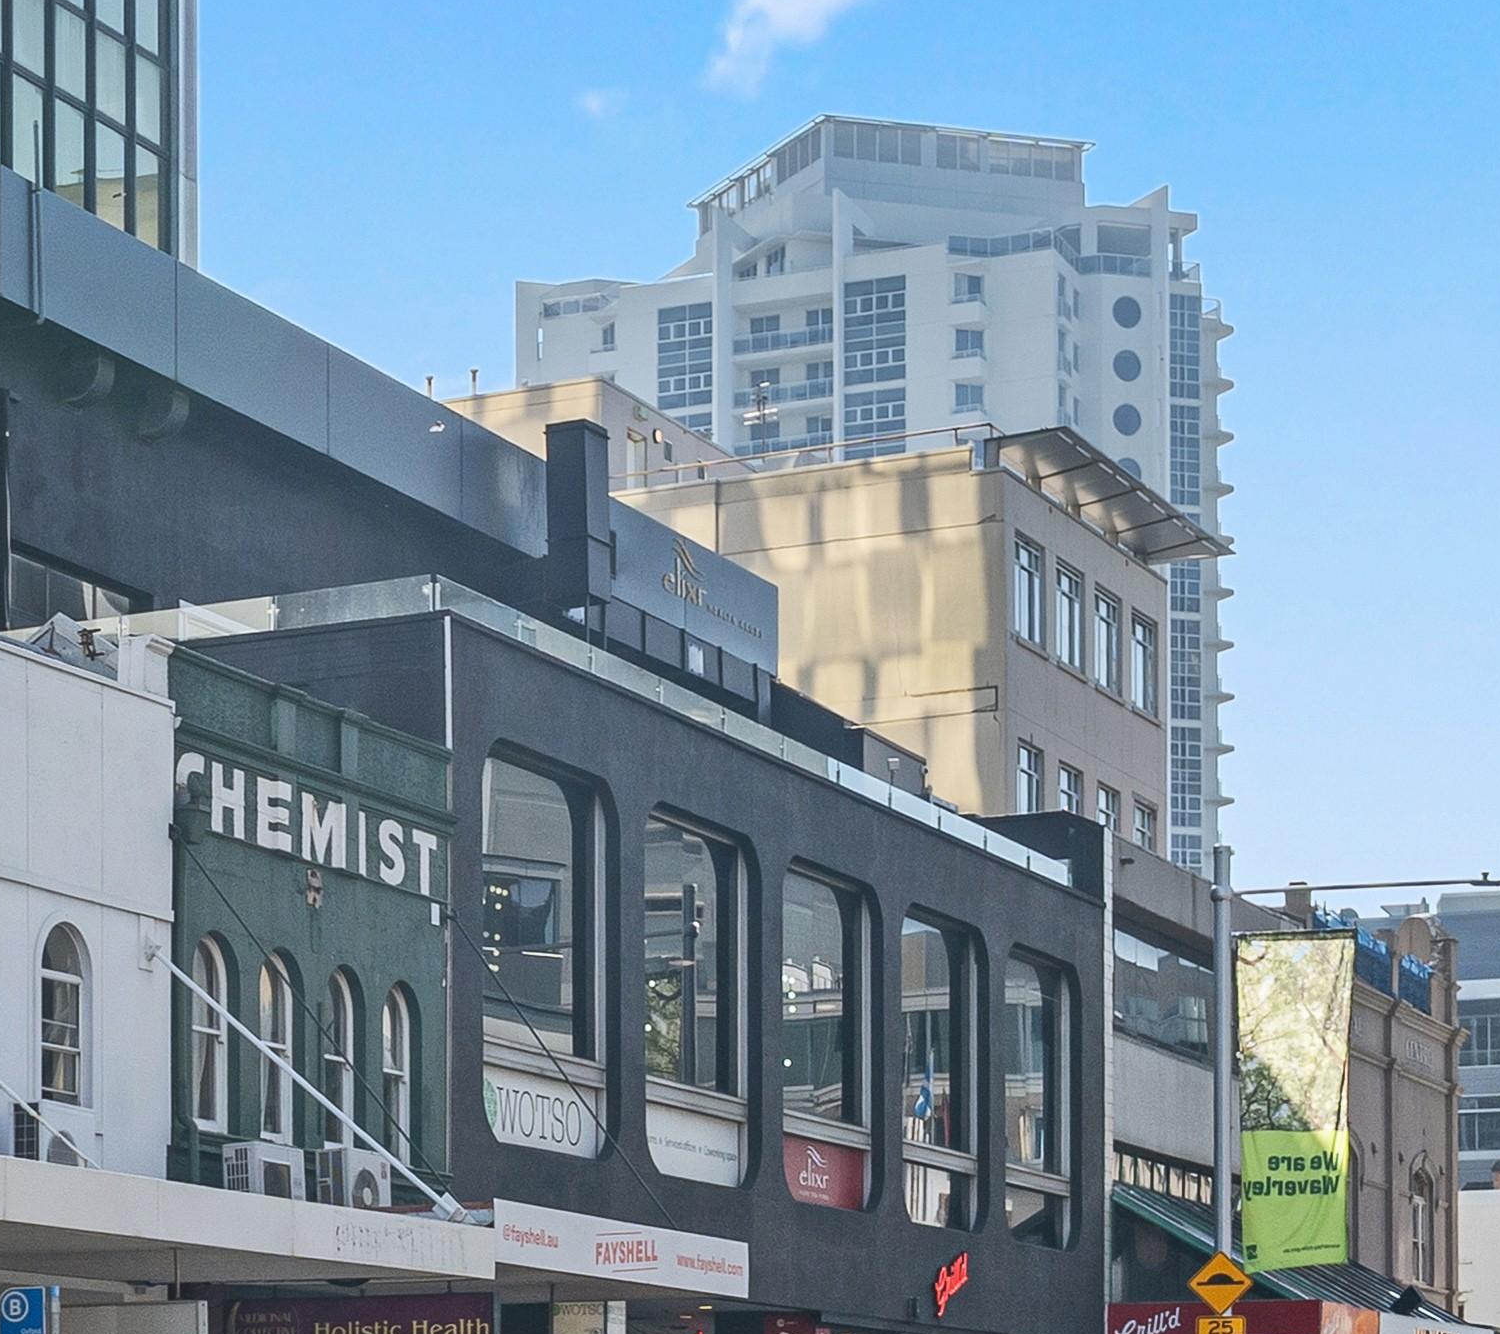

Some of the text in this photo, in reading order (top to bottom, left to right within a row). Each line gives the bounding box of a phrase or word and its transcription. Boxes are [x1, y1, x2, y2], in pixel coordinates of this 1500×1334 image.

[176, 752, 438, 897] CHEMIST
[496, 1086, 583, 1146] WOTSO
[799, 1156, 829, 1188] elixr
[502, 1223, 559, 1248] @fayshell.au
[595, 1239, 658, 1265] FAYSHELL
[675, 1253, 743, 1276] www.fayshell.com
